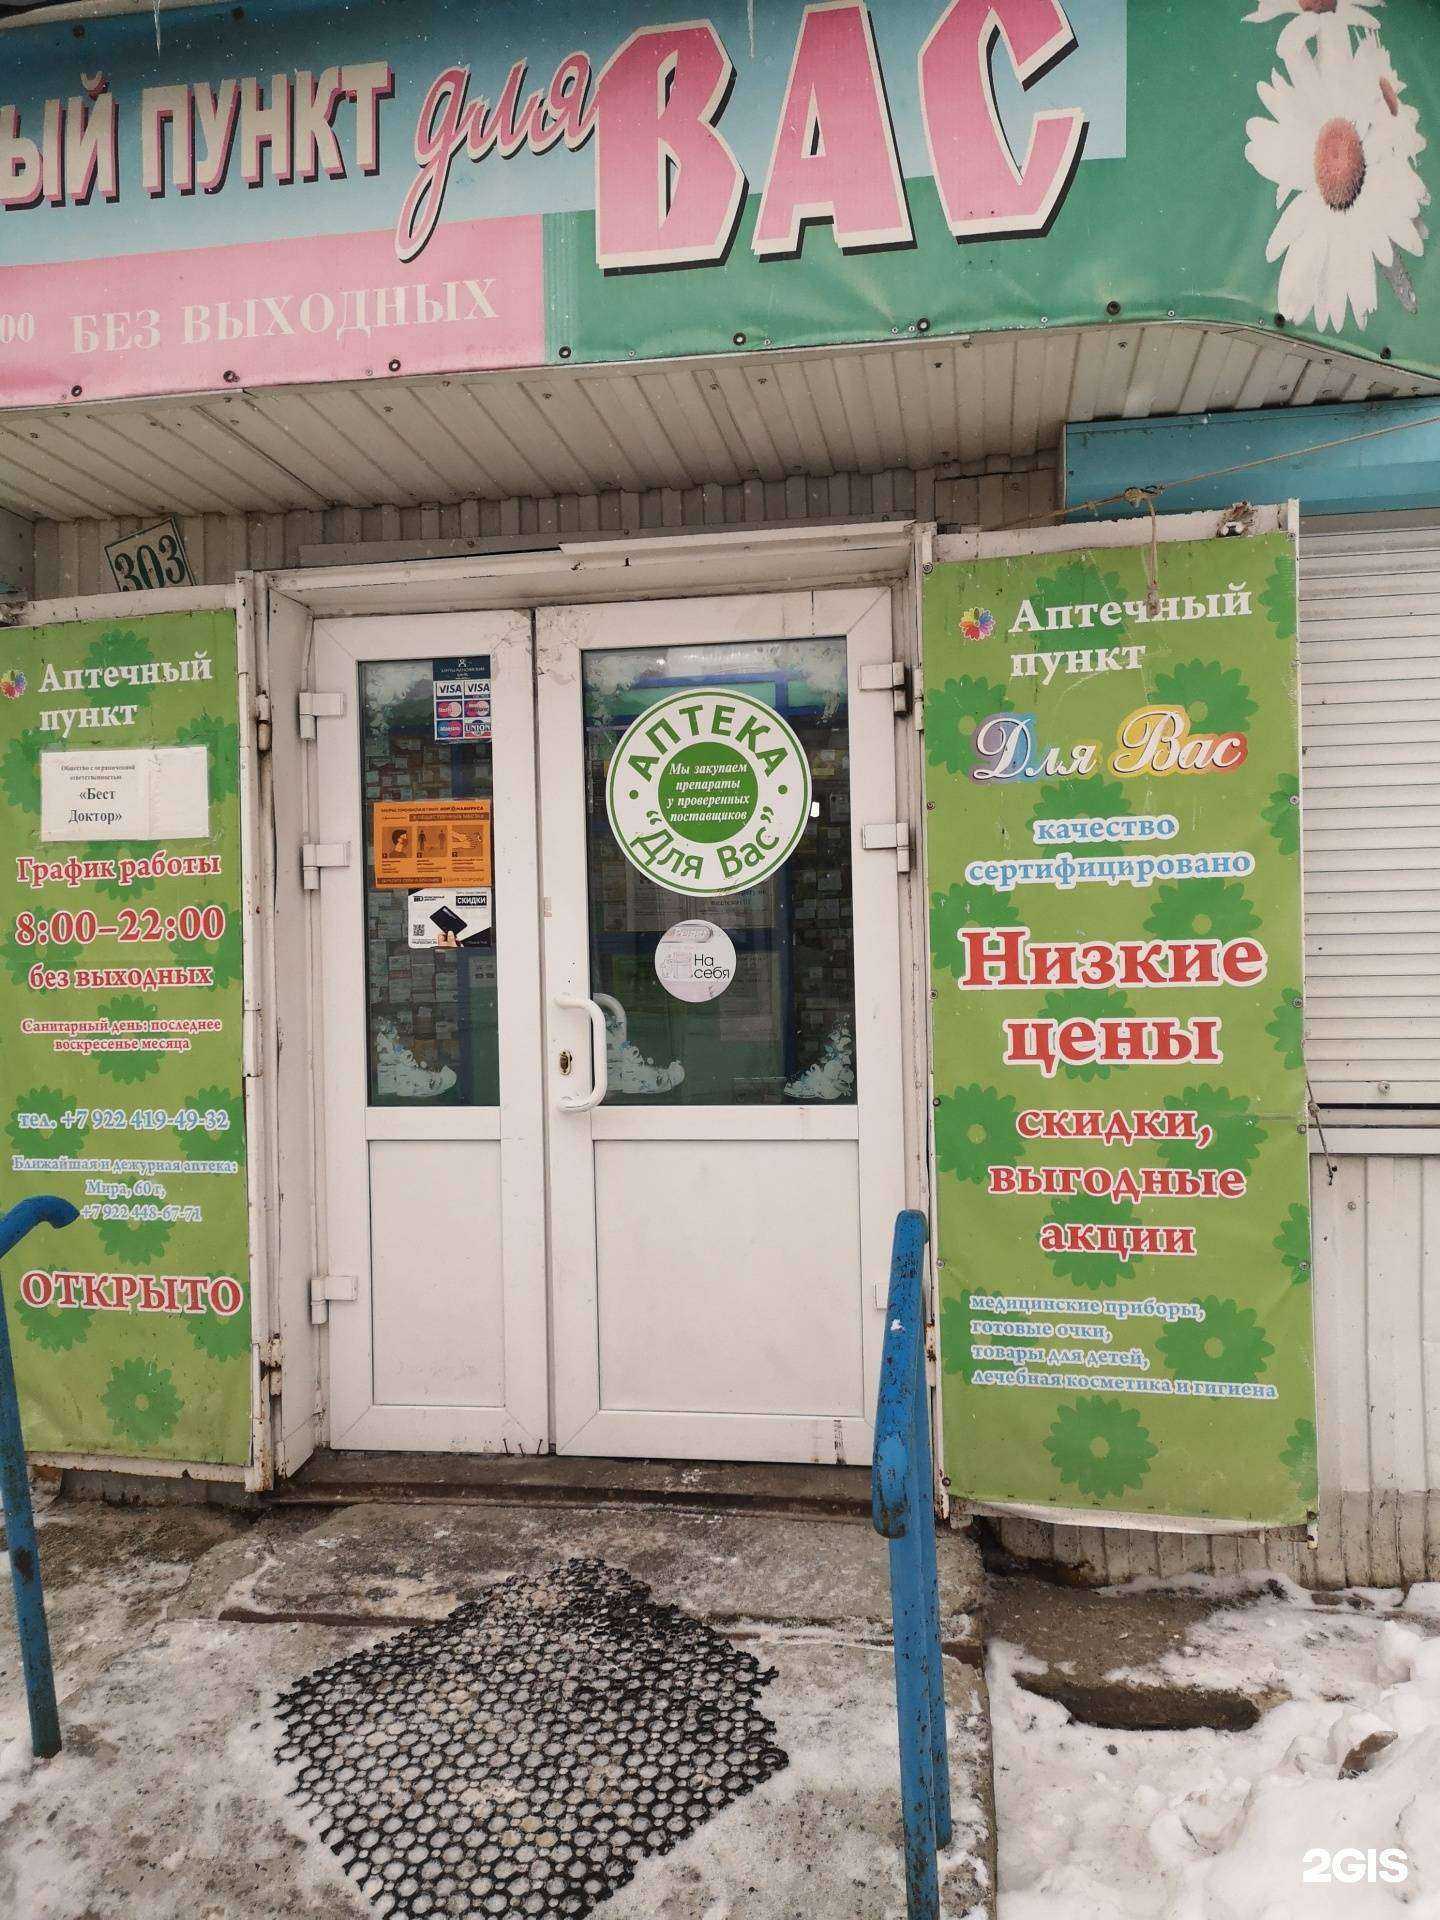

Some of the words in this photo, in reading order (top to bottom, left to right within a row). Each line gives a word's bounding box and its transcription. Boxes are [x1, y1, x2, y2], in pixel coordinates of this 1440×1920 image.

[142, 61, 395, 198] ПУНКТ
[395, 51, 598, 264] для
[595, 0, 1089, 277] ВАС
[69, 308, 162, 354] БЕЗ
[181, 278, 500, 345] ВЫХОДНЫХ
[114, 534, 186, 592] 303
[1008, 581, 1252, 634] Аптечный
[38, 651, 213, 693] Аптечный
[1010, 645, 1146, 685] пункт
[440, 684, 462, 694] VISA
[467, 682, 490, 693] VISA
[39, 704, 138, 738] пункт
[627, 704, 788, 782] АПТЕКА
[971, 714, 1099, 782] Для
[1110, 706, 1245, 776] Вас
[669, 763, 690, 775] Мы
[694, 762, 747, 777] закупаем
[79, 787, 116, 801] «Бест
[675, 780, 741, 792] препараты
[667, 797, 674, 808] у
[677, 794, 750, 807] проверенных
[68, 809, 122, 825] Доктор»
[670, 810, 747, 823] поставщиков
[1032, 814, 1180, 845] качество
[16, 856, 116, 888] График
[118, 850, 221, 885] работы
[965, 851, 1255, 891] сертифицировано
[457, 896, 486, 905] СКИДКИ
[694, 954, 714, 966] На
[958, 927, 1267, 989] Низкие
[28, 963, 70, 988] без
[74, 966, 214, 991] выходных
[693, 966, 730, 979] себя
[21, 1018, 110, 1036] Санитарный
[111, 1020, 149, 1034] день:
[150, 1019, 222, 1032] последнее
[54, 1040, 139, 1055] воскресенье
[141, 1038, 191, 1051] месяца
[1003, 1017, 1222, 1077] цены
[18, 1112, 57, 1129] тел.
[61, 1109, 88, 1129] +7
[91, 1109, 127, 1129] 922
[130, 1109, 230, 1131] 419-49-32
[1016, 1110, 1213, 1148] скидки,
[12, 1155, 99, 1171] Ближайшая
[100, 1160, 110, 1171] и
[112, 1160, 182, 1176] дежурная
[183, 1160, 238, 1173] аптека:
[85, 1179, 132, 1198] Мира,
[988, 1167, 1247, 1203] выгодные
[80, 1204, 101, 1219] +7
[102, 1204, 129, 1220] 922
[1040, 1222, 1197, 1262] акции
[20, 1270, 243, 1316] ОТКРЫТО
[969, 1295, 1101, 1314] медицинские
[1103, 1297, 1206, 1322] приборы,
[970, 1320, 1053, 1337] готовые
[1056, 1323, 1112, 1343] очки,
[971, 1344, 1045, 1365] товары
[1047, 1348, 1084, 1364] для
[1085, 1349, 1150, 1371] детей,
[971, 1369, 1064, 1387] лечебная
[1065, 1373, 1173, 1394] косметика
[1174, 1378, 1190, 1394] и
[1191, 1380, 1278, 1400] гигиена
